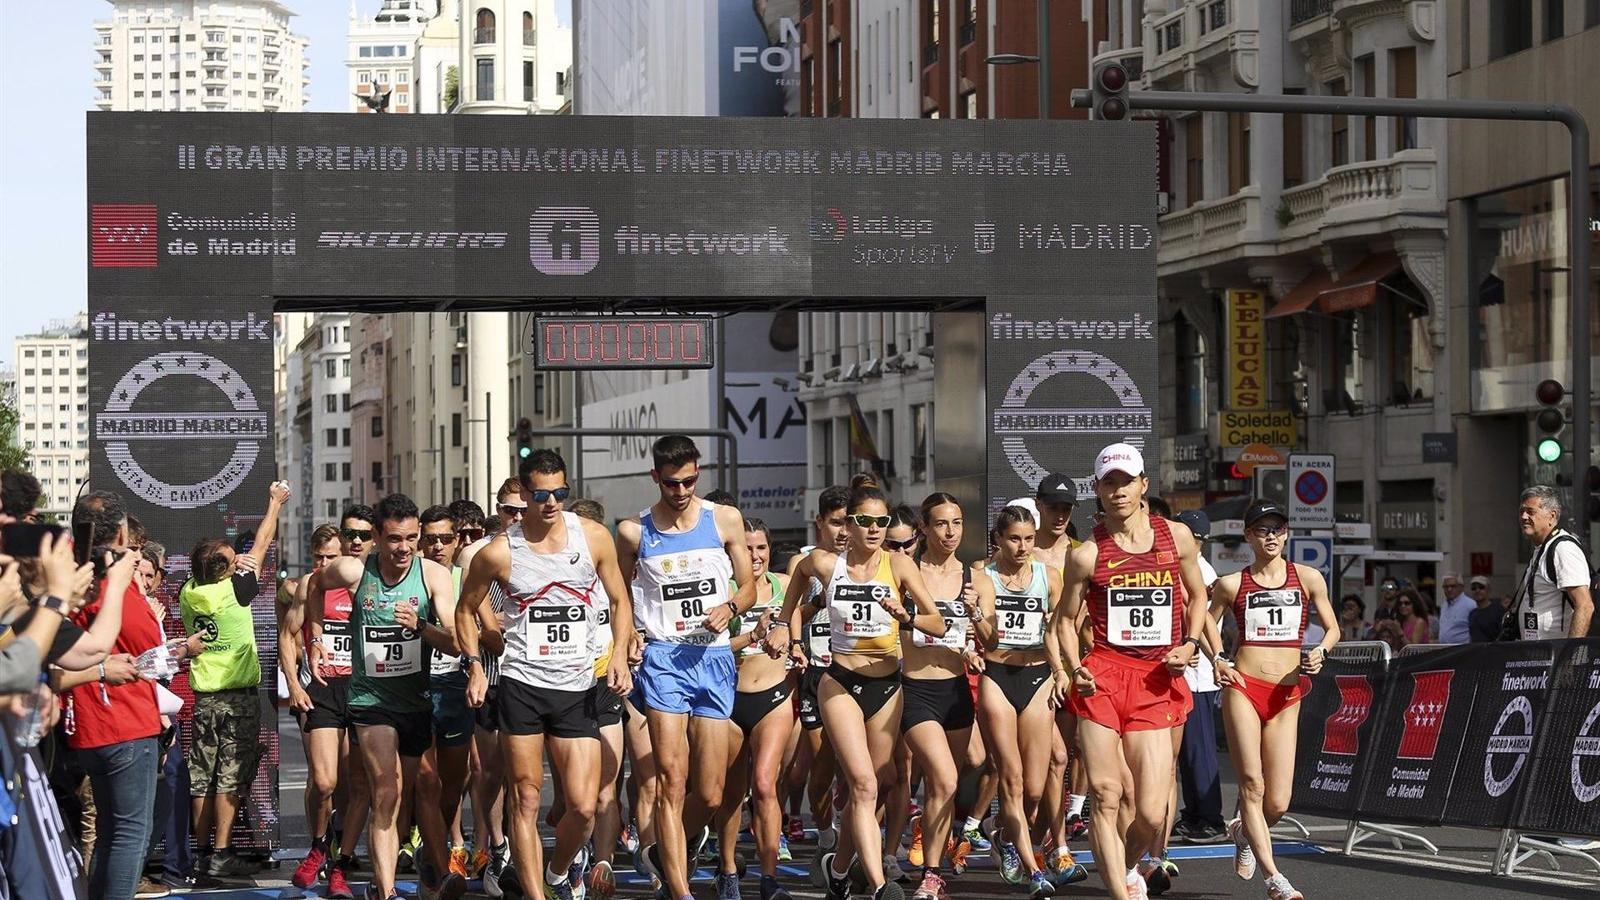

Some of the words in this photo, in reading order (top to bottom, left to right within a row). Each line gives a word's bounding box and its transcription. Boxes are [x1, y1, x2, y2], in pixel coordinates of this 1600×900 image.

[205, 145, 288, 170] GRAN
[296, 145, 408, 171] PREMIO
[415, 147, 646, 173] INTERNACIONAL
[655, 149, 821, 174] FINETWORK
[830, 150, 943, 175] MADRID
[951, 151, 1072, 177] MARCHA
[167, 211, 296, 232] Comunidad
[852, 216, 934, 237] LaLiga
[316, 231, 508, 249] SKECHERS
[613, 225, 792, 257] finetwork
[1018, 223, 1153, 250] MADRID
[167, 238, 198, 256] de
[208, 238, 296, 256] Madrid
[91, 312, 270, 341] finetwork
[990, 313, 1154, 339] finetwork
[1234, 291, 1262, 407] PELUCAS
[100, 418, 178, 434] MADRID
[183, 418, 265, 434] MARCHA
[997, 415, 1070, 429] MADRID
[1075, 415, 1150, 429] MARCHA
[1225, 413, 1292, 429] Soledad
[1228, 430, 1290, 446] Cabello
[1102, 453, 1132, 464] CHINA
[741, 487, 797, 498] exterior
[1294, 541, 1328, 569] P
[1109, 570, 1174, 588] CHINA
[681, 598, 703, 619] 80
[852, 603, 872, 621] 31
[1267, 608, 1283, 625] 11
[1004, 612, 1025, 629] 34
[1129, 608, 1154, 628] 68
[547, 624, 570, 643] 56
[333, 636, 352, 652] 50
[383, 643, 404, 661] 79
[433, 648, 443, 660] 4
[1501, 671, 1549, 691] finetwork
[1575, 739, 1598, 751] MADRID
[1317, 761, 1354, 775] Comunidad
[1391, 766, 1431, 781] Comunidad
[1310, 779, 1321, 790] de
[1321, 779, 1350, 793] Madrid
[1386, 785, 1398, 797] de
[1397, 785, 1426, 799] Madrid
